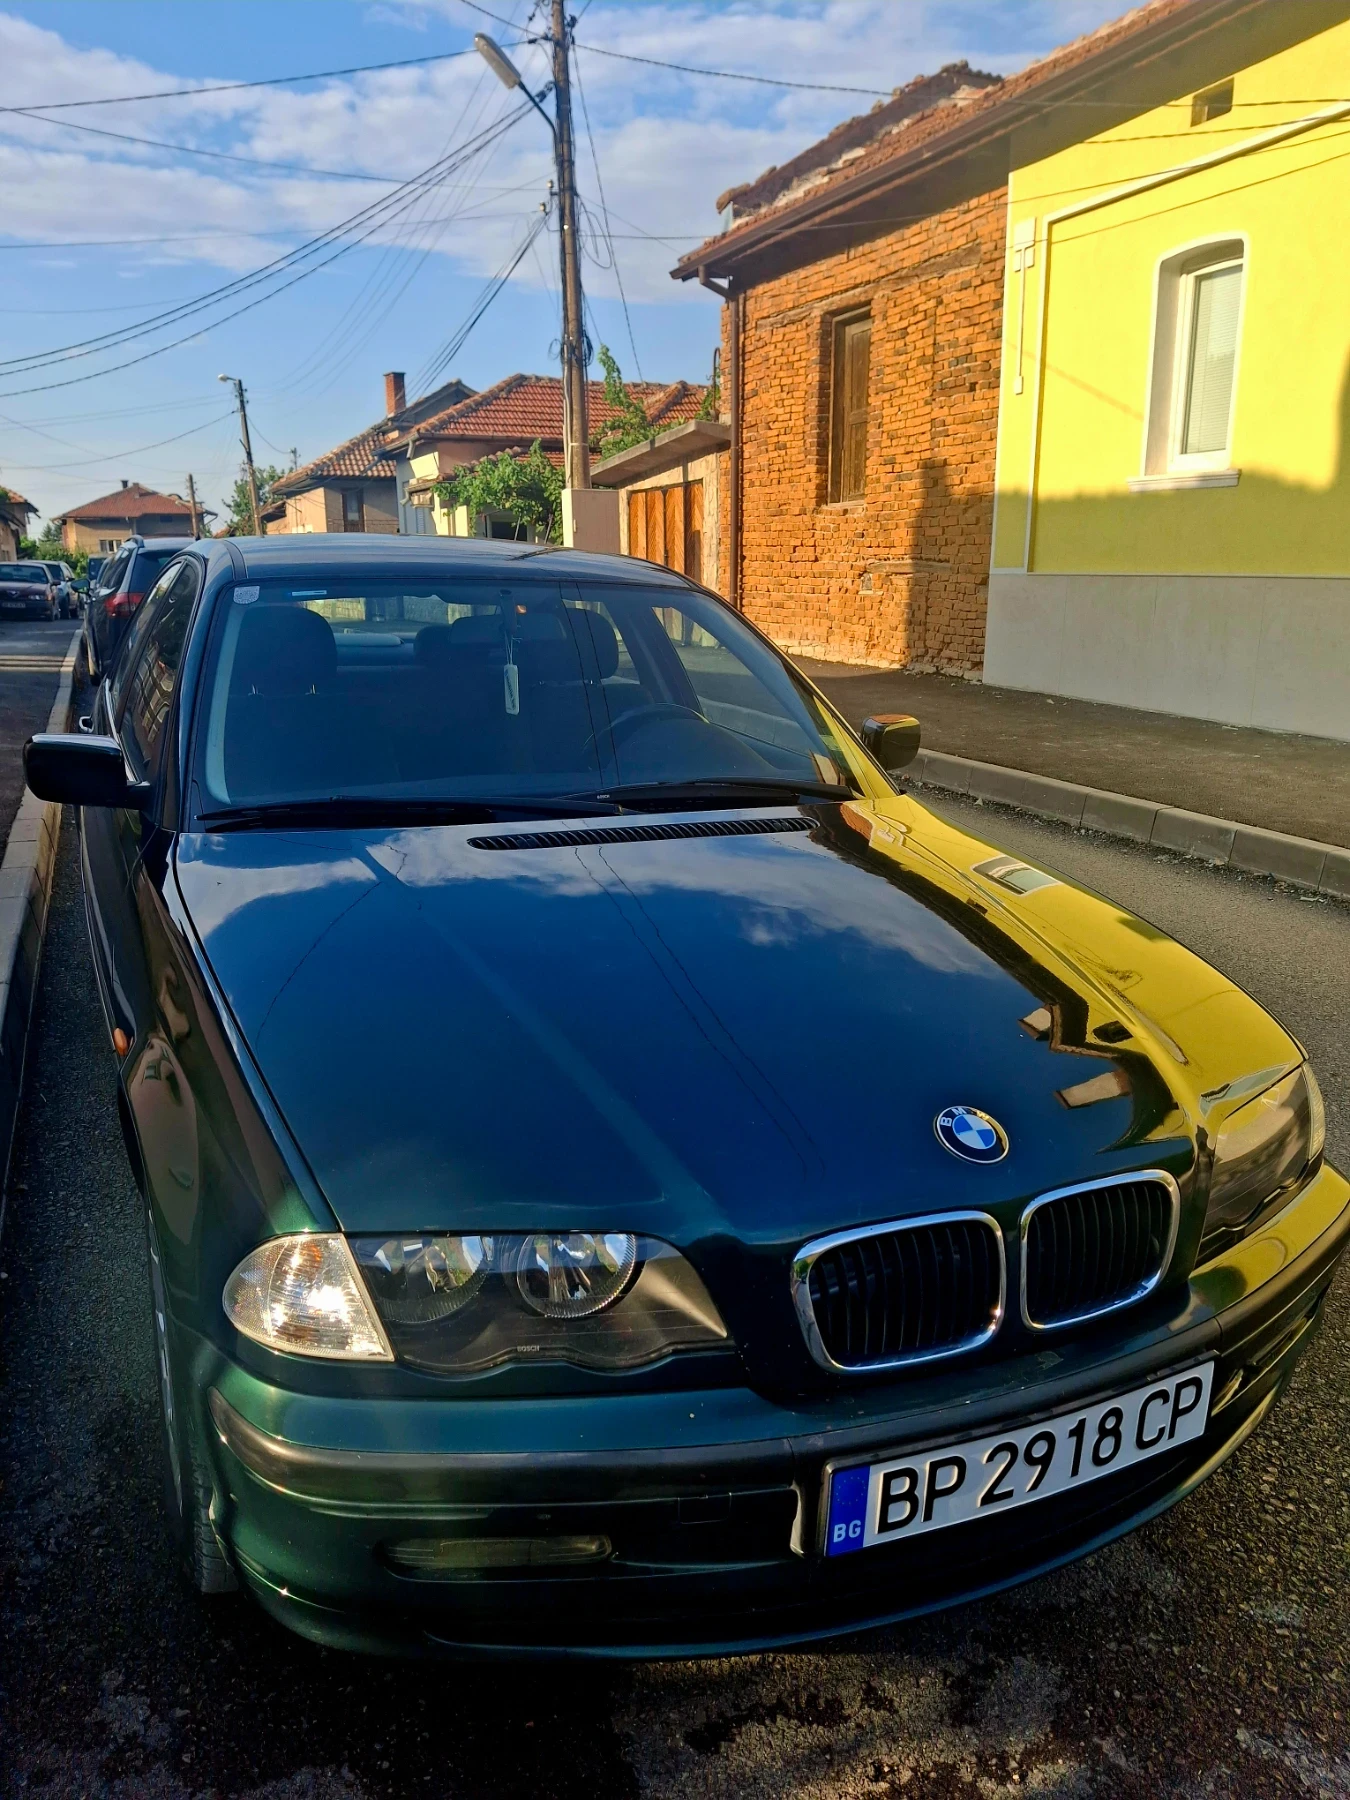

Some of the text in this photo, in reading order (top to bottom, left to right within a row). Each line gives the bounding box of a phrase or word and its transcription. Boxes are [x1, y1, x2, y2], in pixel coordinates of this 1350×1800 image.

[940, 1107, 990, 1126] BMW
[875, 1376, 1203, 1534] BP 2918 CP
[833, 1519, 861, 1543] BG
